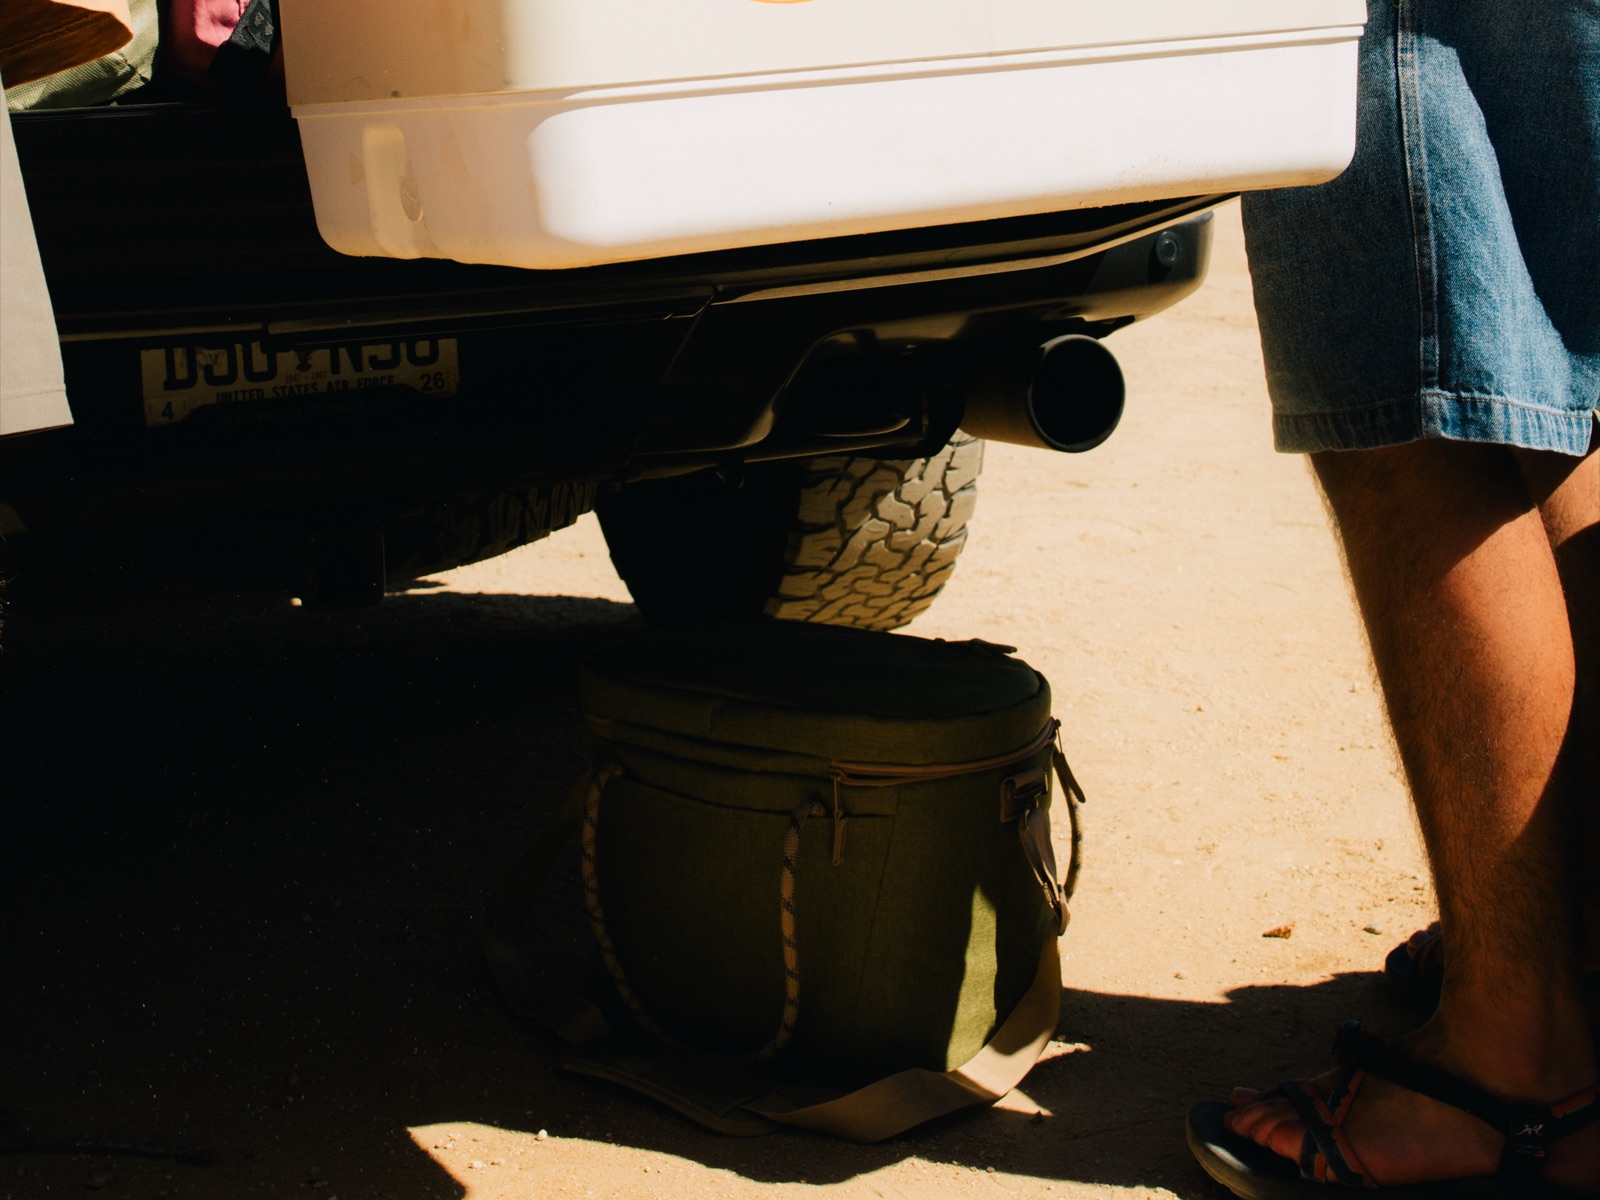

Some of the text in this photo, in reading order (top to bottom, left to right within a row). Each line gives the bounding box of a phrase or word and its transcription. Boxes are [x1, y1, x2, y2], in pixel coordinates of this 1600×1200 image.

[216, 375, 394, 402] UNITED STATES AIR FORCE
[420, 371, 445, 391] 26
[161, 401, 174, 419] 4
